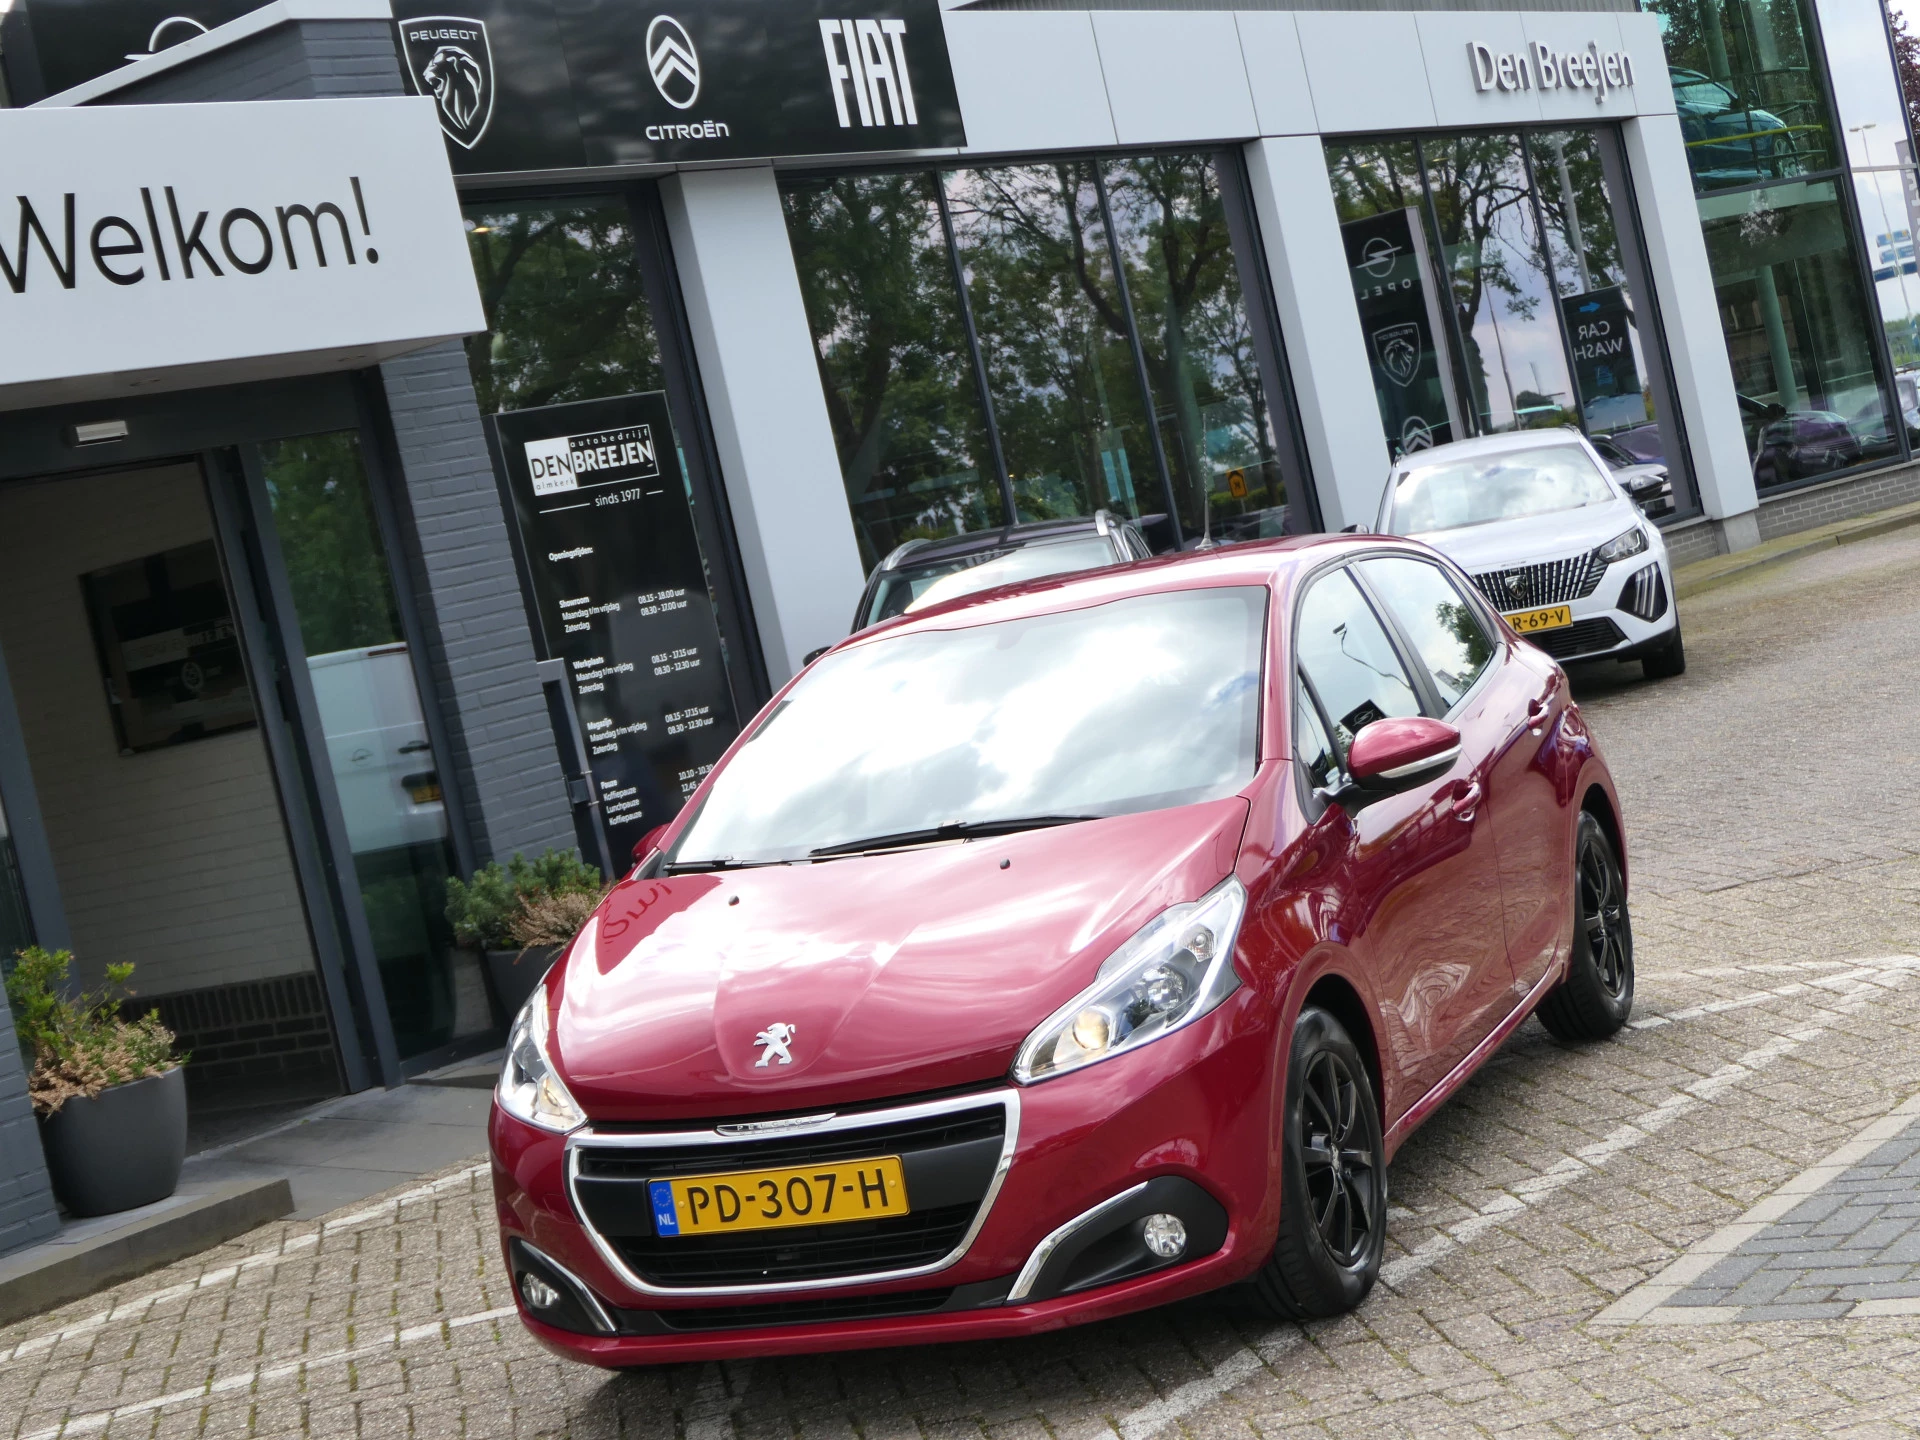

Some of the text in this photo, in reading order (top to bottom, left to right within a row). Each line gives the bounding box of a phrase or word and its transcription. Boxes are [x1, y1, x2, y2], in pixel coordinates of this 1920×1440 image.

[409, 27, 478, 43] PEUGEOT
[819, 19, 918, 128] FIAT
[1466, 40, 1636, 104] Den Breejen
[0, 176, 380, 294] Welkom!
[570, 428, 649, 448] autobedrijf
[530, 440, 654, 479] DEN BREEJEN
[536, 478, 574, 491] almkerk
[595, 488, 641, 507] sinds 1977
[548, 546, 594, 562] Openingstijden:
[559, 596, 590, 608] Showroom
[562, 602, 620, 620] Maandag t/m vrijdag
[564, 622, 590, 633] Zaterdag
[572, 656, 604, 669] Werkplaats
[690, 659, 700, 667] uur
[576, 662, 634, 681] Maandag t/m vrijdag
[578, 682, 604, 694] Zaterdag
[699, 706, 709, 714] uur
[590, 722, 647, 742] Maandag t/m vrijdag
[592, 742, 618, 754] Zaterdag
[600, 779, 618, 789] Pauze
[603, 786, 636, 801] Koffiepauze
[606, 799, 639, 814] Lunchpauze
[609, 811, 642, 825] Koffiepauze
[737, 1118, 812, 1131] PEUGEOT
[686, 1168, 889, 1225] PD-307-H
[659, 1213, 675, 1226] NL
